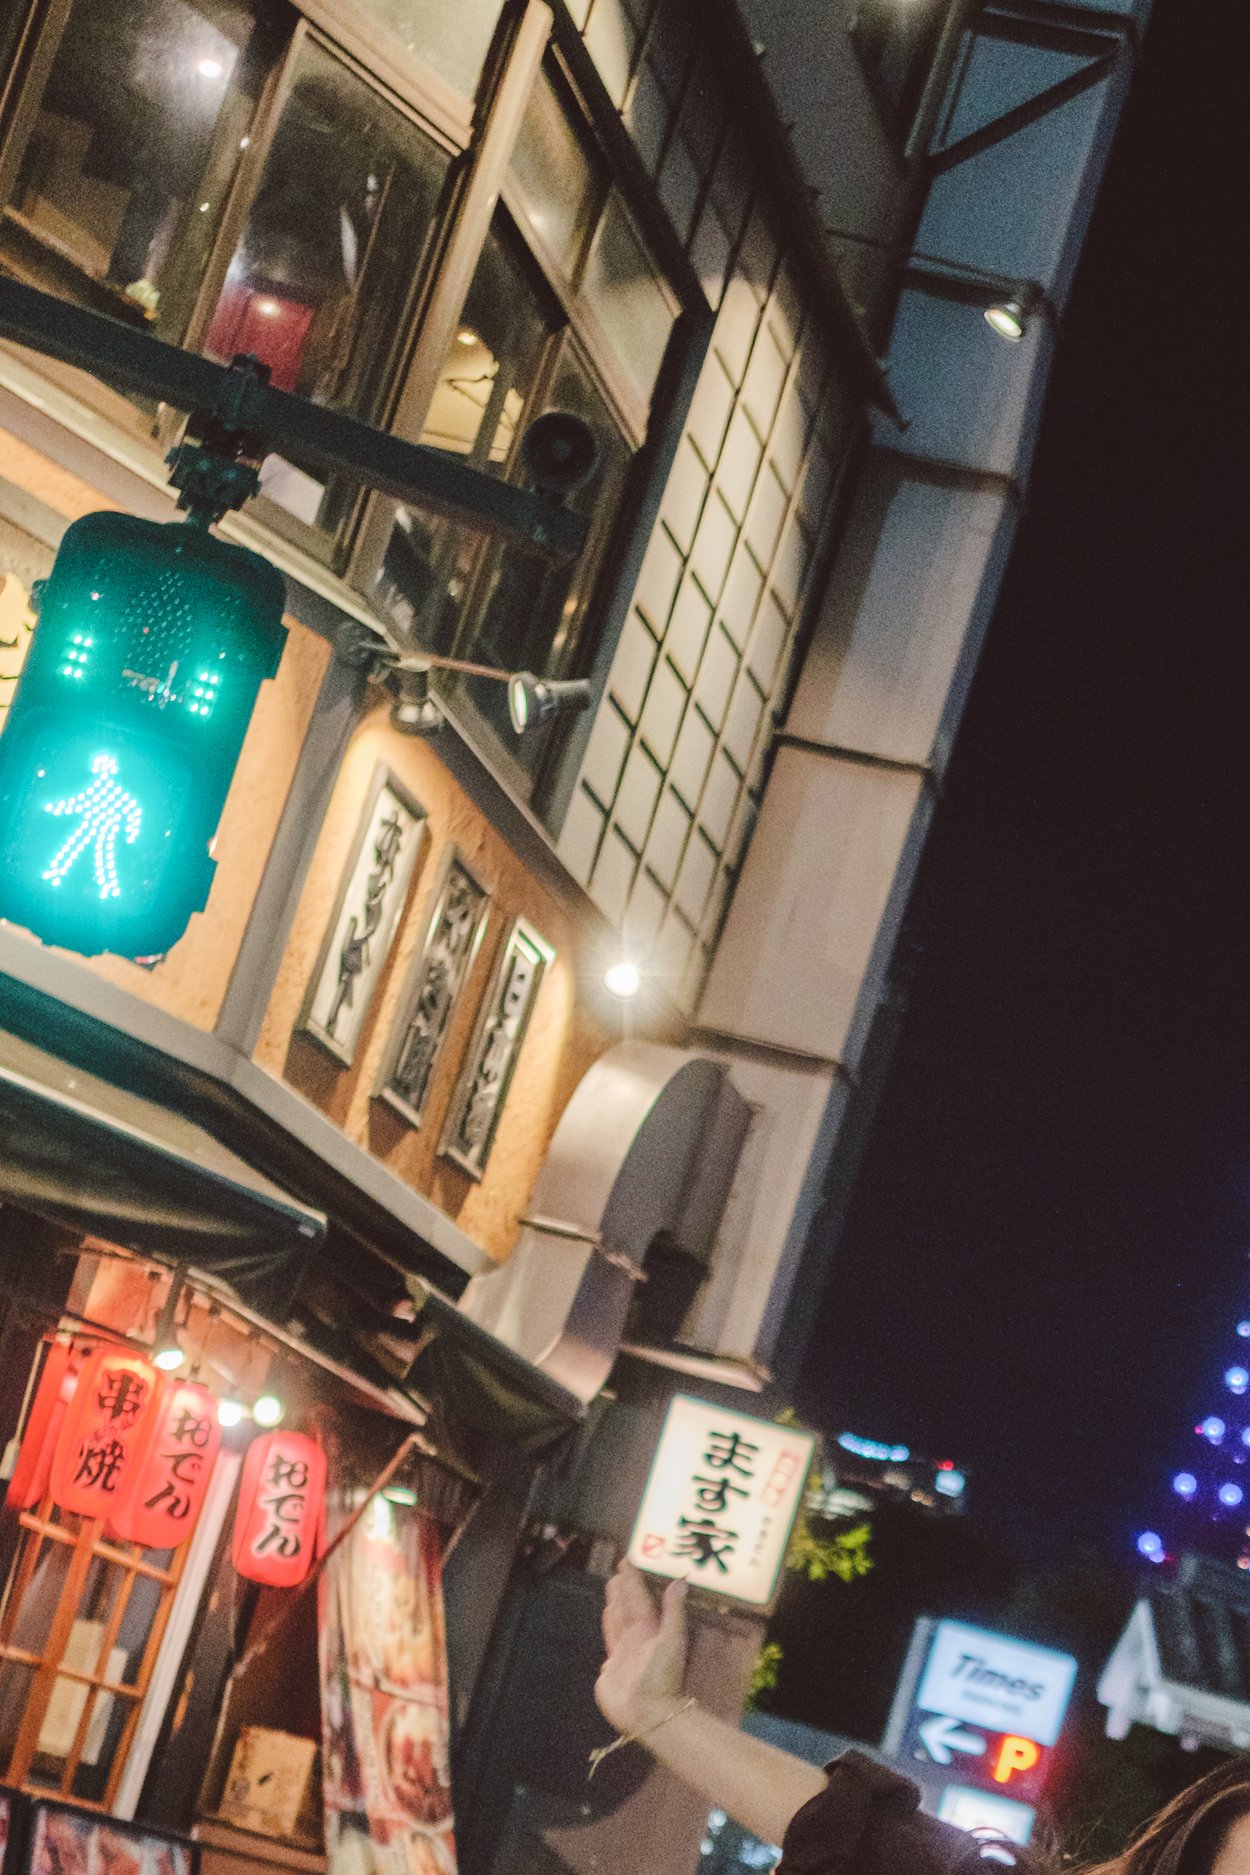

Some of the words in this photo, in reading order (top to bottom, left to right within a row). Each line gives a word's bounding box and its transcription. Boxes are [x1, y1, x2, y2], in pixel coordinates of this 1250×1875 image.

[74, 1373, 144, 1492] 串焼
[143, 1408, 213, 1519] おでん
[254, 1453, 309, 1558] おでん
[671, 1431, 760, 1574] ます家
[951, 1653, 1046, 1701] Times
[993, 1733, 1039, 1784] P
